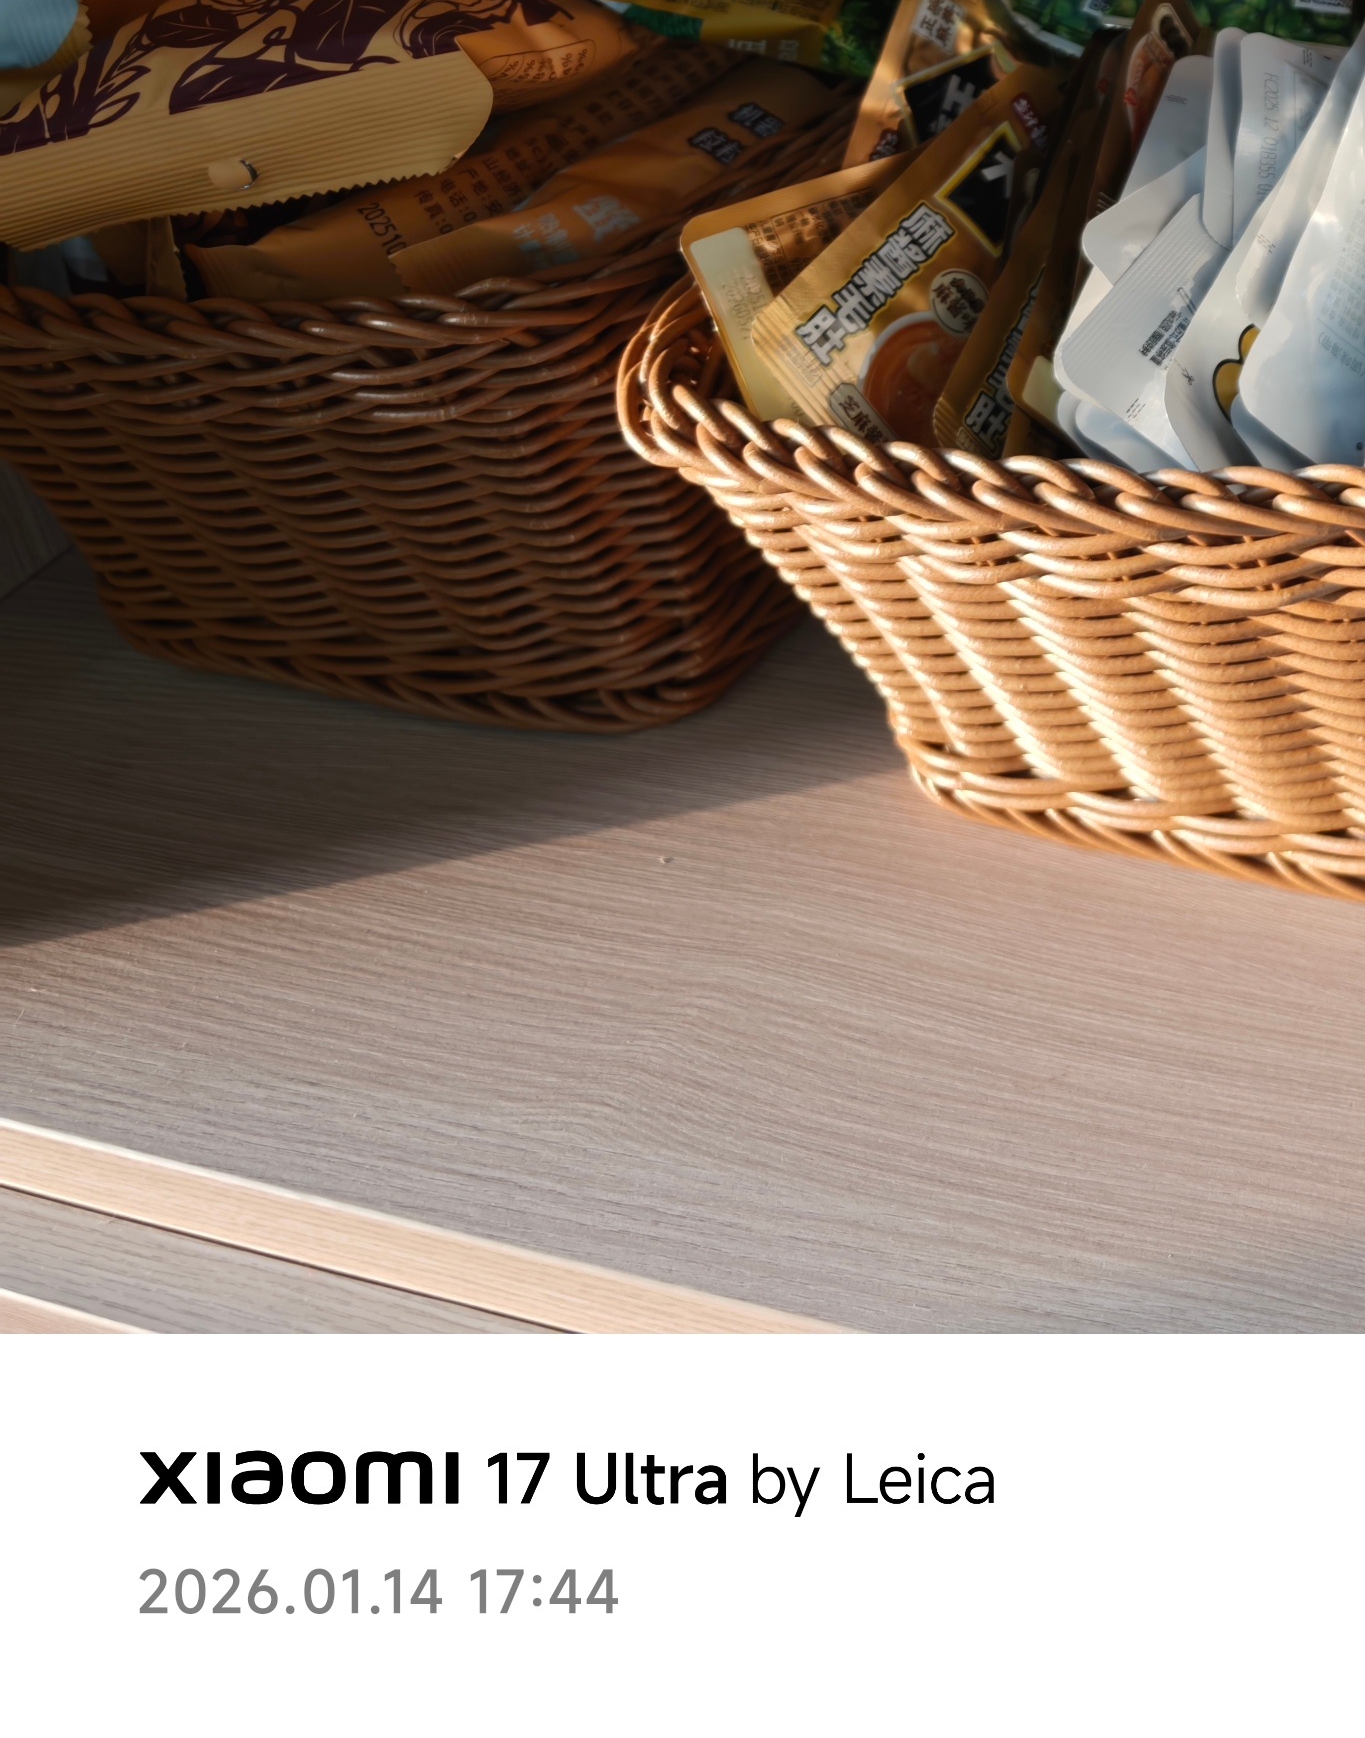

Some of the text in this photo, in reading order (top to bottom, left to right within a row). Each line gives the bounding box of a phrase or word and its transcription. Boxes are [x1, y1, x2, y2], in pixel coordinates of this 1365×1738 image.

[1264, 116, 1279, 131] 12
[794, 199, 957, 366] 麻酱素毛肚
